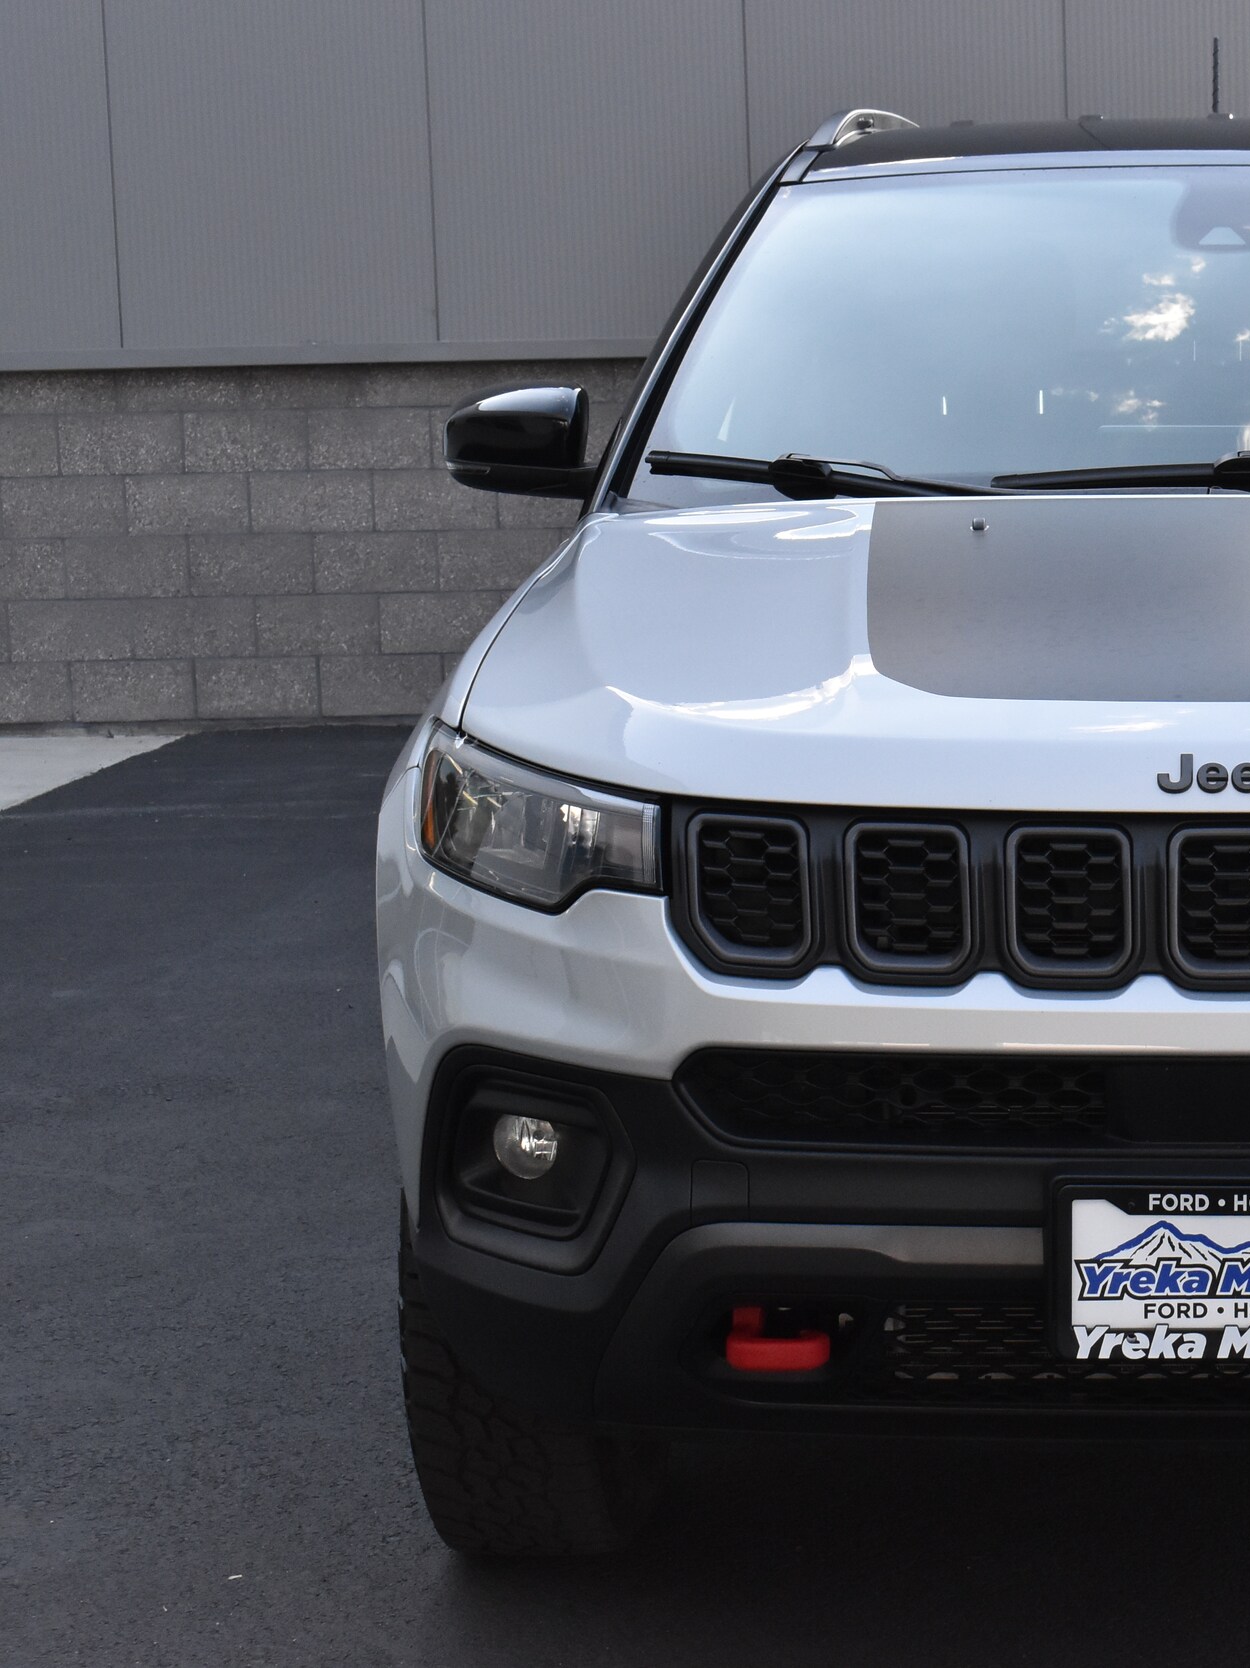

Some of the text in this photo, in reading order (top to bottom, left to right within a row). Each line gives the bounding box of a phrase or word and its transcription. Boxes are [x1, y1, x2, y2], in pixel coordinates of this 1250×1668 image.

[1148, 1194, 1210, 1212] FORD
[1079, 1260, 1213, 1297] Yreka
[1143, 1302, 1208, 1319] FORD
[1072, 1324, 1208, 1360] Yreka
